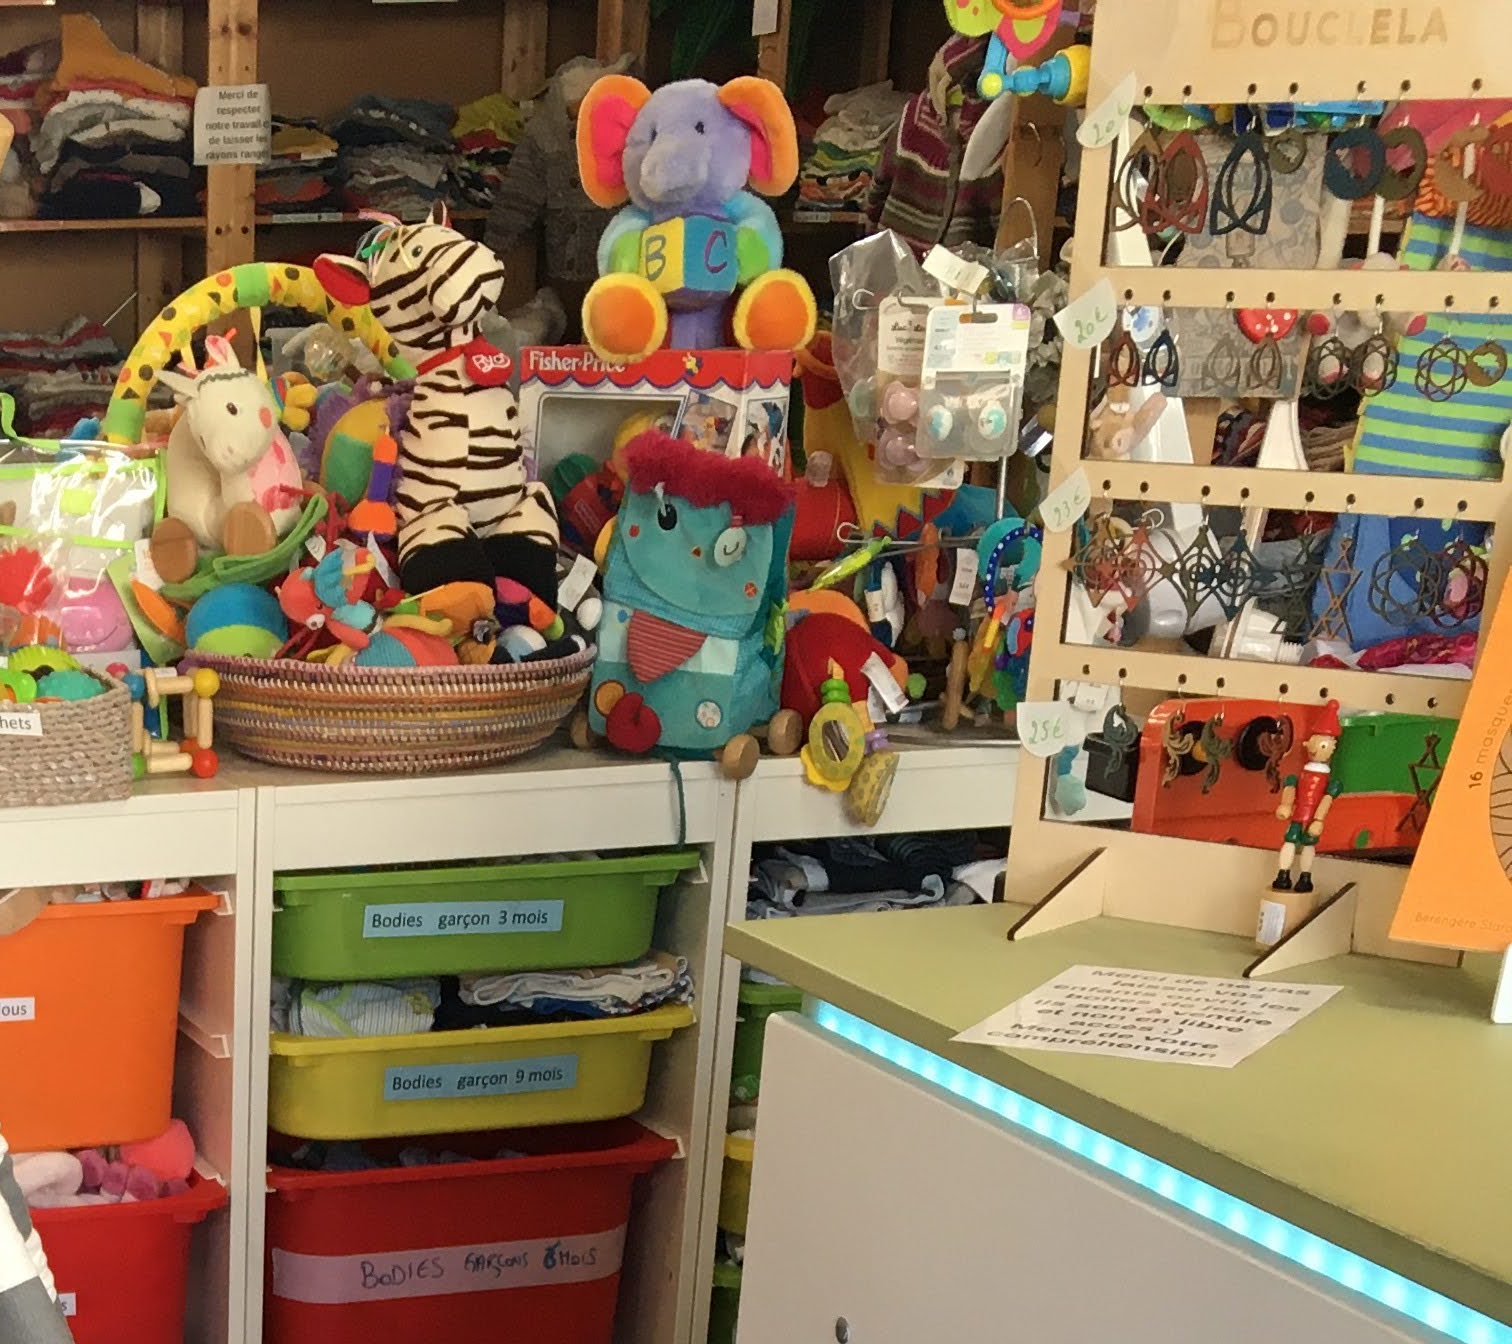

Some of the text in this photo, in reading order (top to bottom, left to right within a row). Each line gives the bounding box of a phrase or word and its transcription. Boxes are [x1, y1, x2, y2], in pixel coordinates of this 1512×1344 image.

[219, 89, 258, 99] Merci de
[216, 105, 261, 116] respecter
[205, 121, 230, 130] notre
[232, 119, 262, 128] travail
[208, 135, 220, 144] de
[223, 135, 254, 144] laisser
[205, 151, 238, 160] rayons
[645, 229, 728, 282] B C
[1468, 770, 1484, 789] 16
[371, 910, 549, 930] Bodies garçon 3 mois
[1091, 969, 1312, 996] Merci de ne pas
[1112, 980, 1264, 1000] laisser vos
[1053, 984, 1302, 1013] enfants ouvrir les
[1160, 1001, 1195, 1009] de
[1201, 1004, 1265, 1016] jeux
[1037, 1008, 1244, 1033] et non en libre
[1074, 1003, 1140, 1013] sont
[1173, 1010, 1273, 1026] vendre
[1010, 1022, 1219, 1049] Merci de votre
[392, 1066, 564, 1091] Bodies garçon 9 mois
